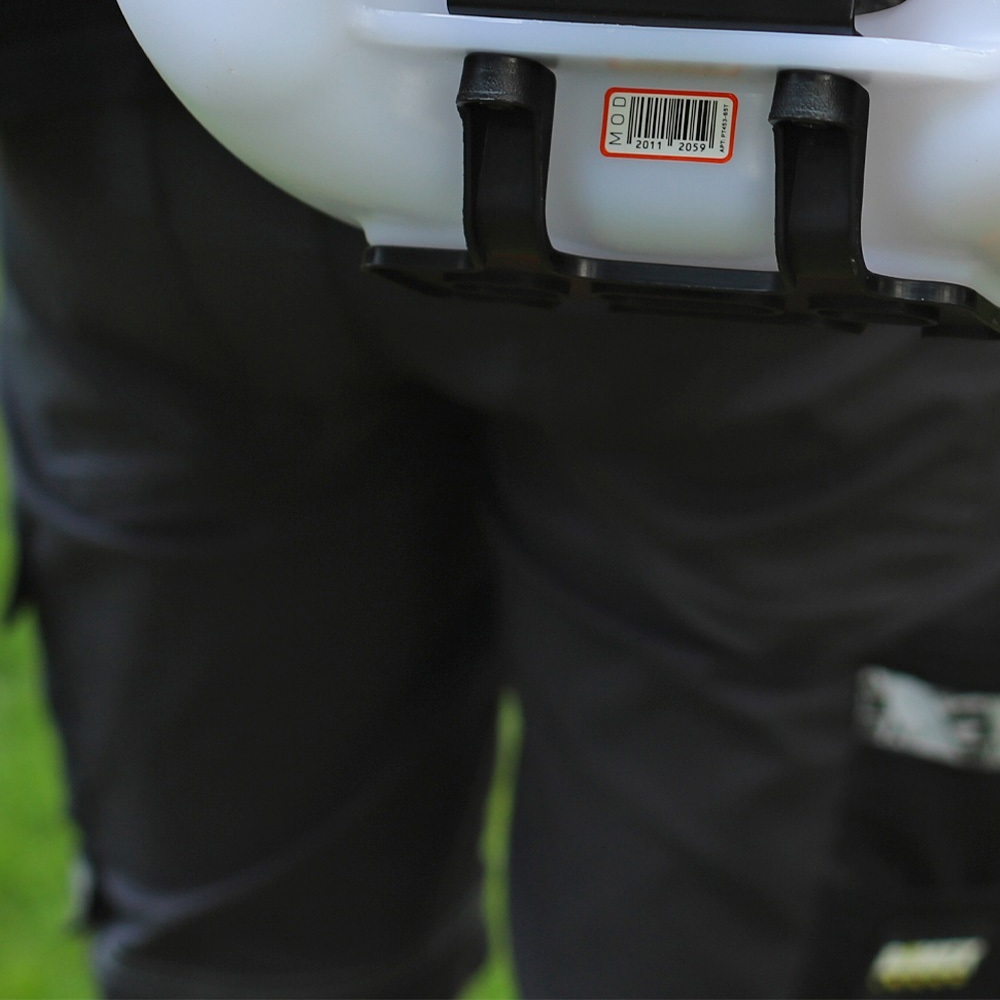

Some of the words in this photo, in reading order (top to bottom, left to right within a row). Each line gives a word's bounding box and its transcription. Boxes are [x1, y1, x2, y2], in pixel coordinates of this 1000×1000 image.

[609, 96, 627, 146] MOD
[635, 140, 662, 150] 2011
[678, 142, 706, 152] 2059
